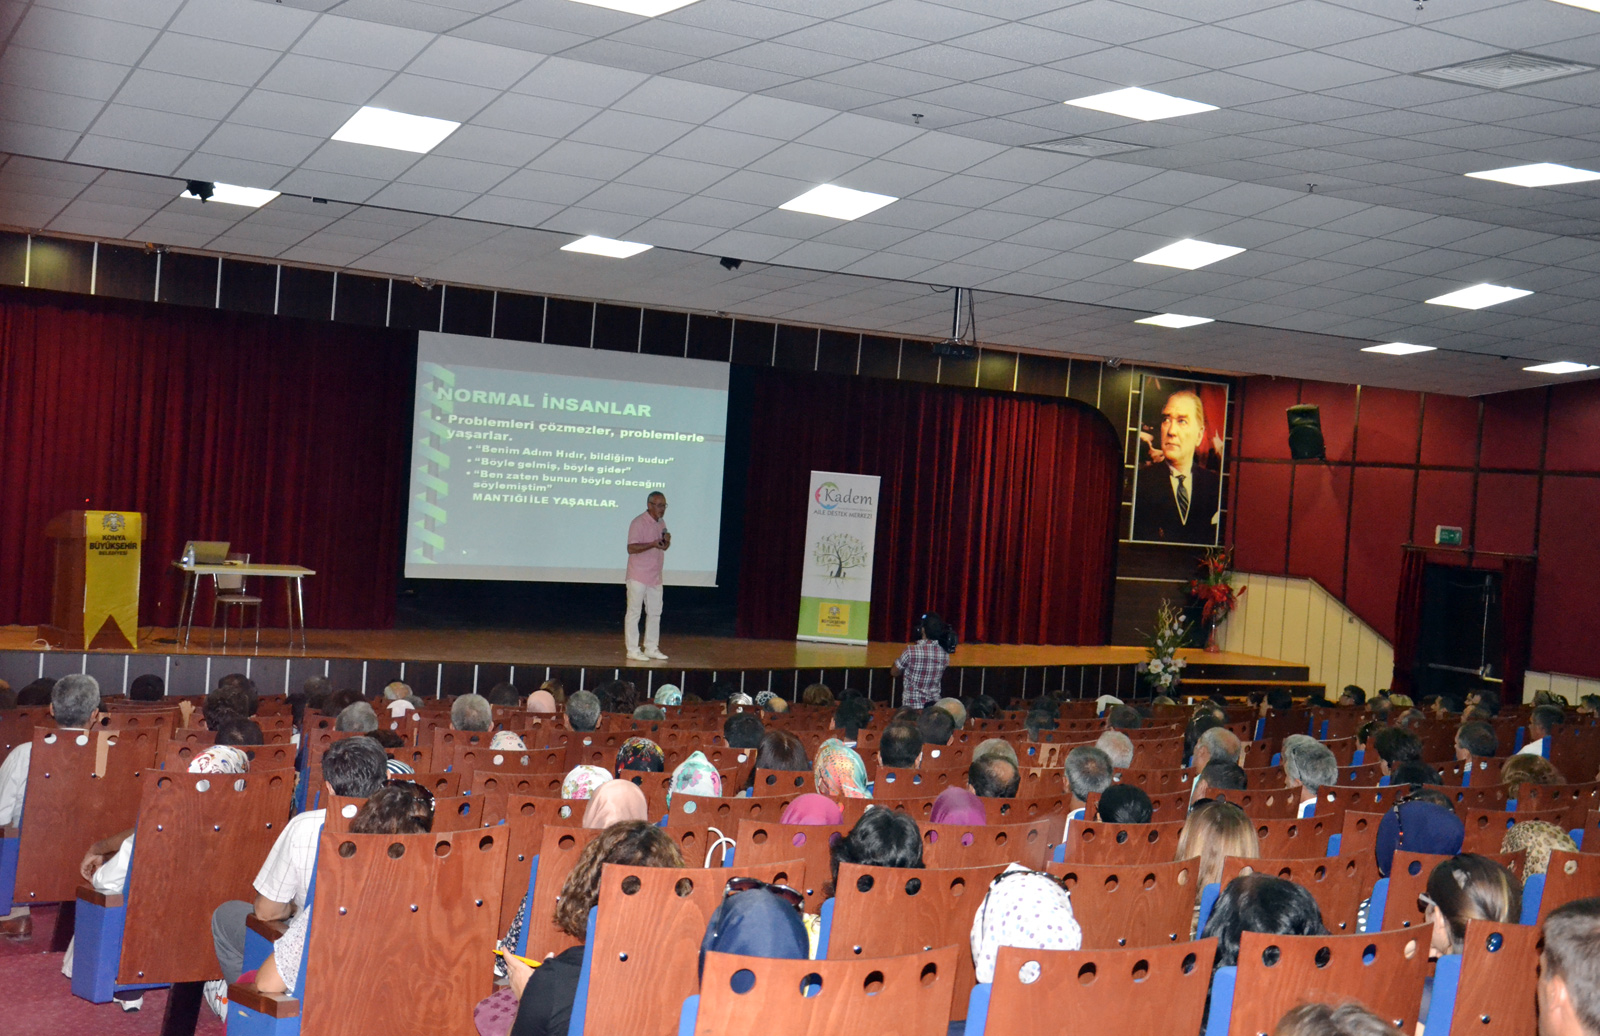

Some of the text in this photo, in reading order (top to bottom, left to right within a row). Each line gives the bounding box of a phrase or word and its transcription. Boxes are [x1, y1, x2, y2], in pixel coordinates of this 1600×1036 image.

[437, 387, 652, 417] NORMAL İNSANLAR
[446, 429, 513, 441] yaşarlar.
[448, 414, 705, 443] Problemleri çözmezler, problemlerle
[522, 447, 553, 457] Adım
[556, 449, 587, 461] Hıdır,
[590, 452, 635, 463] bildiğim
[517, 459, 561, 472] gelmiş,
[563, 463, 595, 473] böyle
[505, 472, 539, 481] zaten
[542, 474, 578, 483] bunun
[581, 476, 612, 487] böyle
[614, 479, 666, 490] olacağını
[472, 493, 528, 503] MANTIĞI
[552, 496, 619, 508] YAŞARLAR.
[824, 487, 873, 506] Kadem
[827, 510, 848, 518] DESTEK
[89, 541, 138, 550] BÜYÜKŞEHİR
